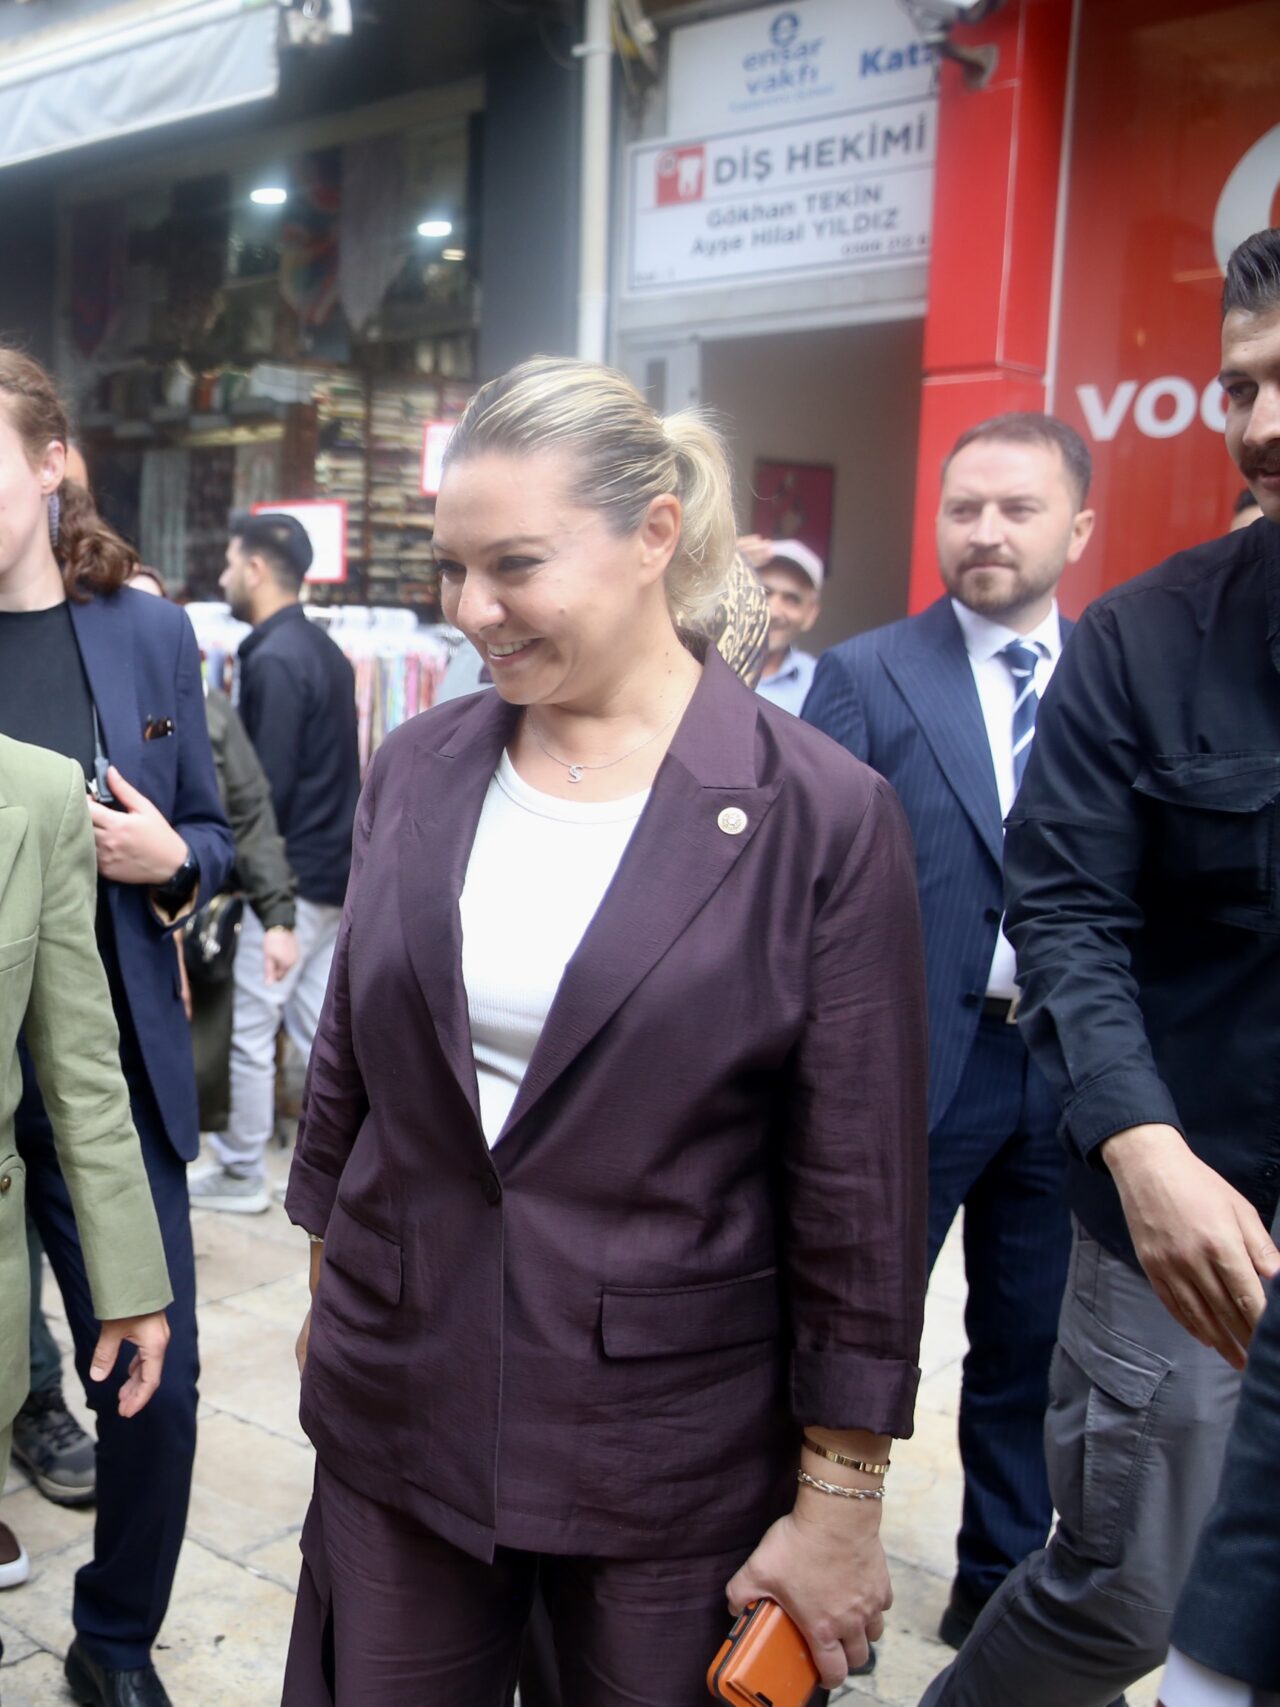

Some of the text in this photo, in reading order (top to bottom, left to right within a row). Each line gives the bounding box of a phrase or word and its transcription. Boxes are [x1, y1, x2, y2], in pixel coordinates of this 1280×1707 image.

[712, 113, 928, 186] DİŞ HEKİMİ
[706, 182, 883, 230] Gökhan TEKİN
[812, 206, 899, 239] YILDIZ
